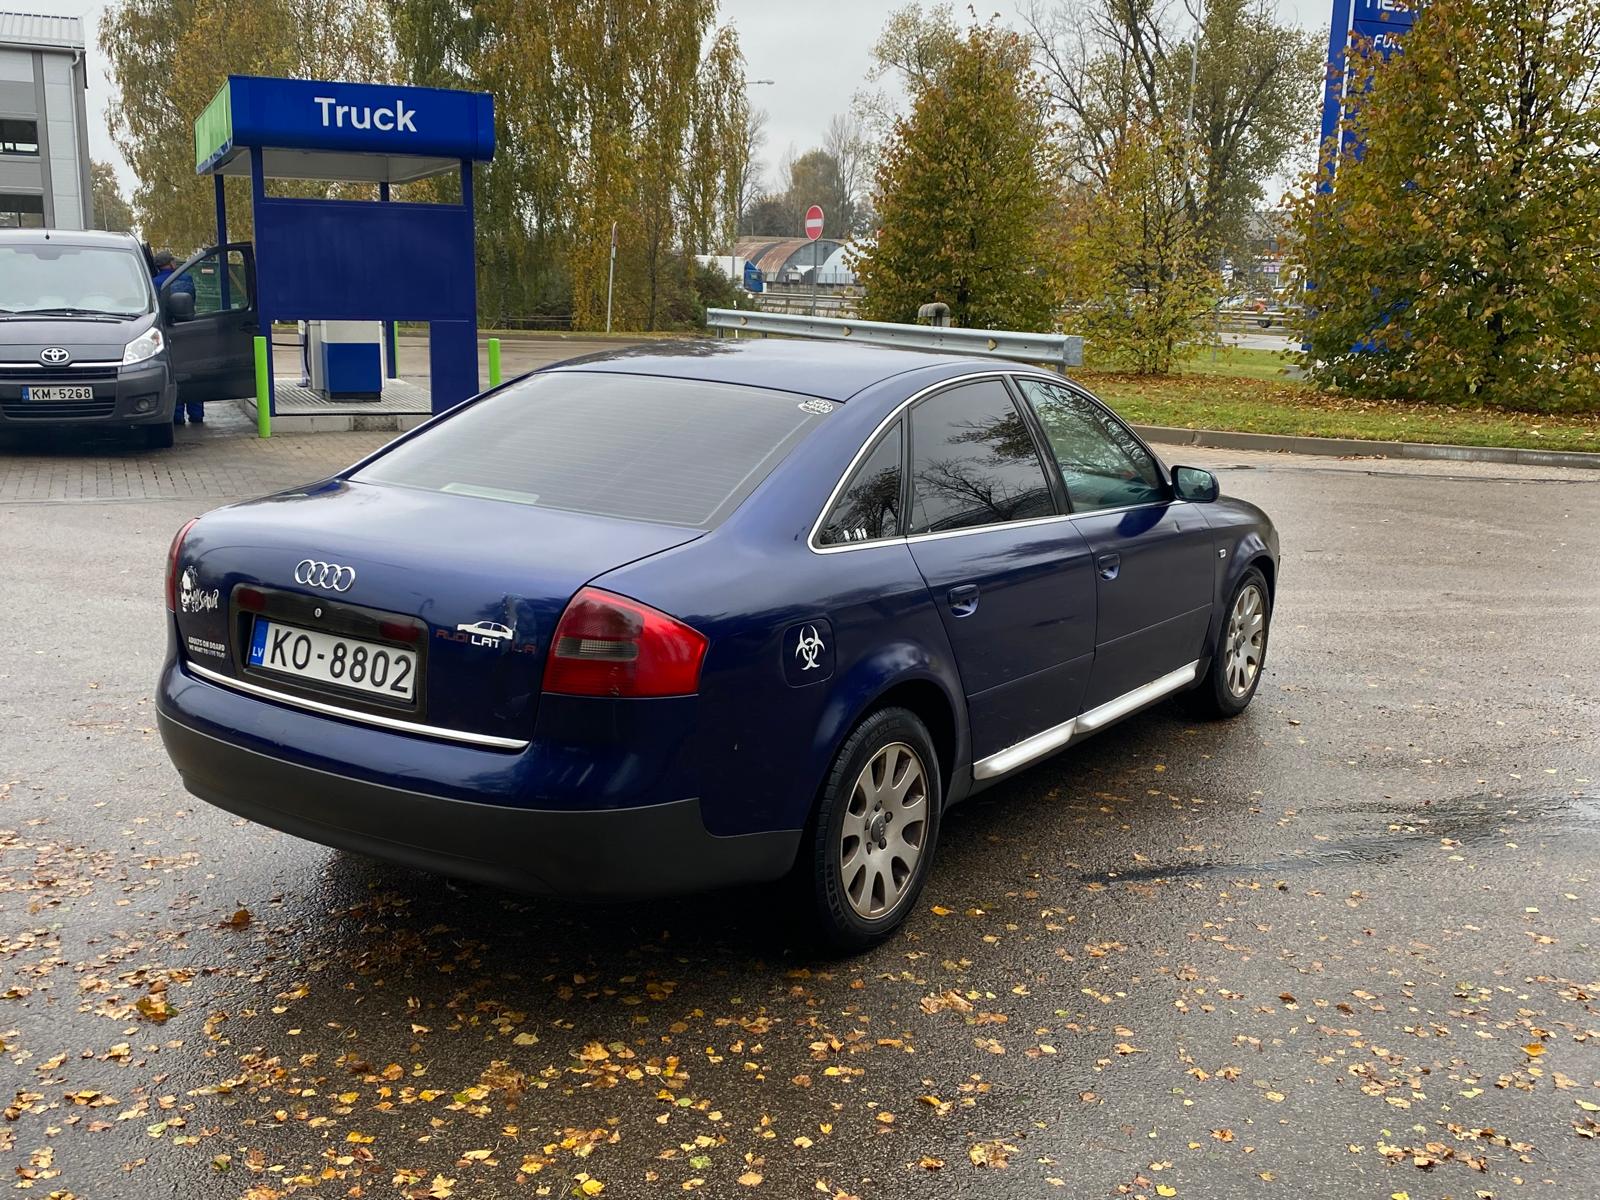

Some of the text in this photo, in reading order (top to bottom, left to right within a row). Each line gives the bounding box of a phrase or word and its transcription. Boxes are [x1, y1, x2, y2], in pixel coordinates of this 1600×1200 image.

[314, 97, 417, 132] Truck
[31, 388, 91, 399] KM-5268
[210, 641, 225, 651] BOARD
[471, 635, 501, 649] LAT
[251, 646, 264, 657] LV
[270, 628, 412, 694] KO-8802
